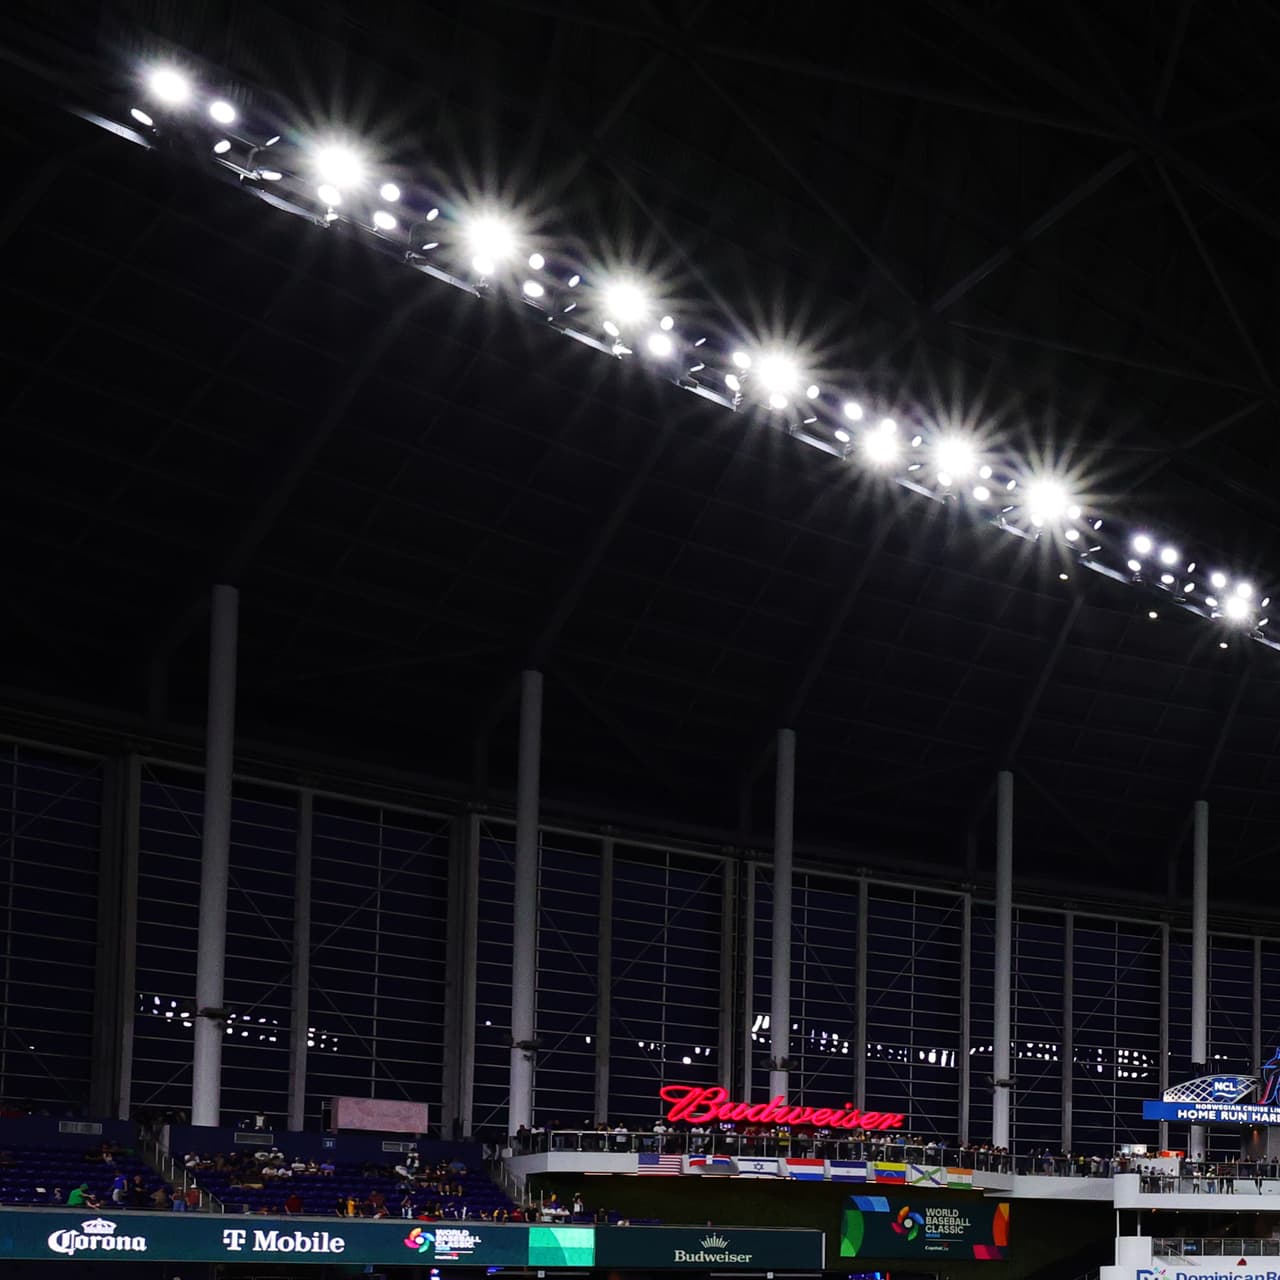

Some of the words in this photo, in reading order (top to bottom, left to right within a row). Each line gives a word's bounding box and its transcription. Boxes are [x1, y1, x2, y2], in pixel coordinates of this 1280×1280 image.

[1213, 1081, 1237, 1092] NCL
[659, 1085, 905, 1131] Budweiser
[1195, 1103, 1242, 1111] NORWEGIAN
[1242, 1105, 1269, 1113] CRUISE
[1178, 1109, 1216, 1120] HOME
[1220, 1111, 1249, 1121] RUN
[925, 1207, 959, 1217] WORLD
[925, 1216, 971, 1226] BASEBALL
[435, 1228, 470, 1236] WORLD
[925, 1225, 964, 1234] CLASSIC
[47, 1228, 147, 1256] Corona
[253, 1230, 345, 1253] Mobile
[435, 1235, 481, 1243] BASEBALL
[674, 1249, 752, 1263] Budweiser
